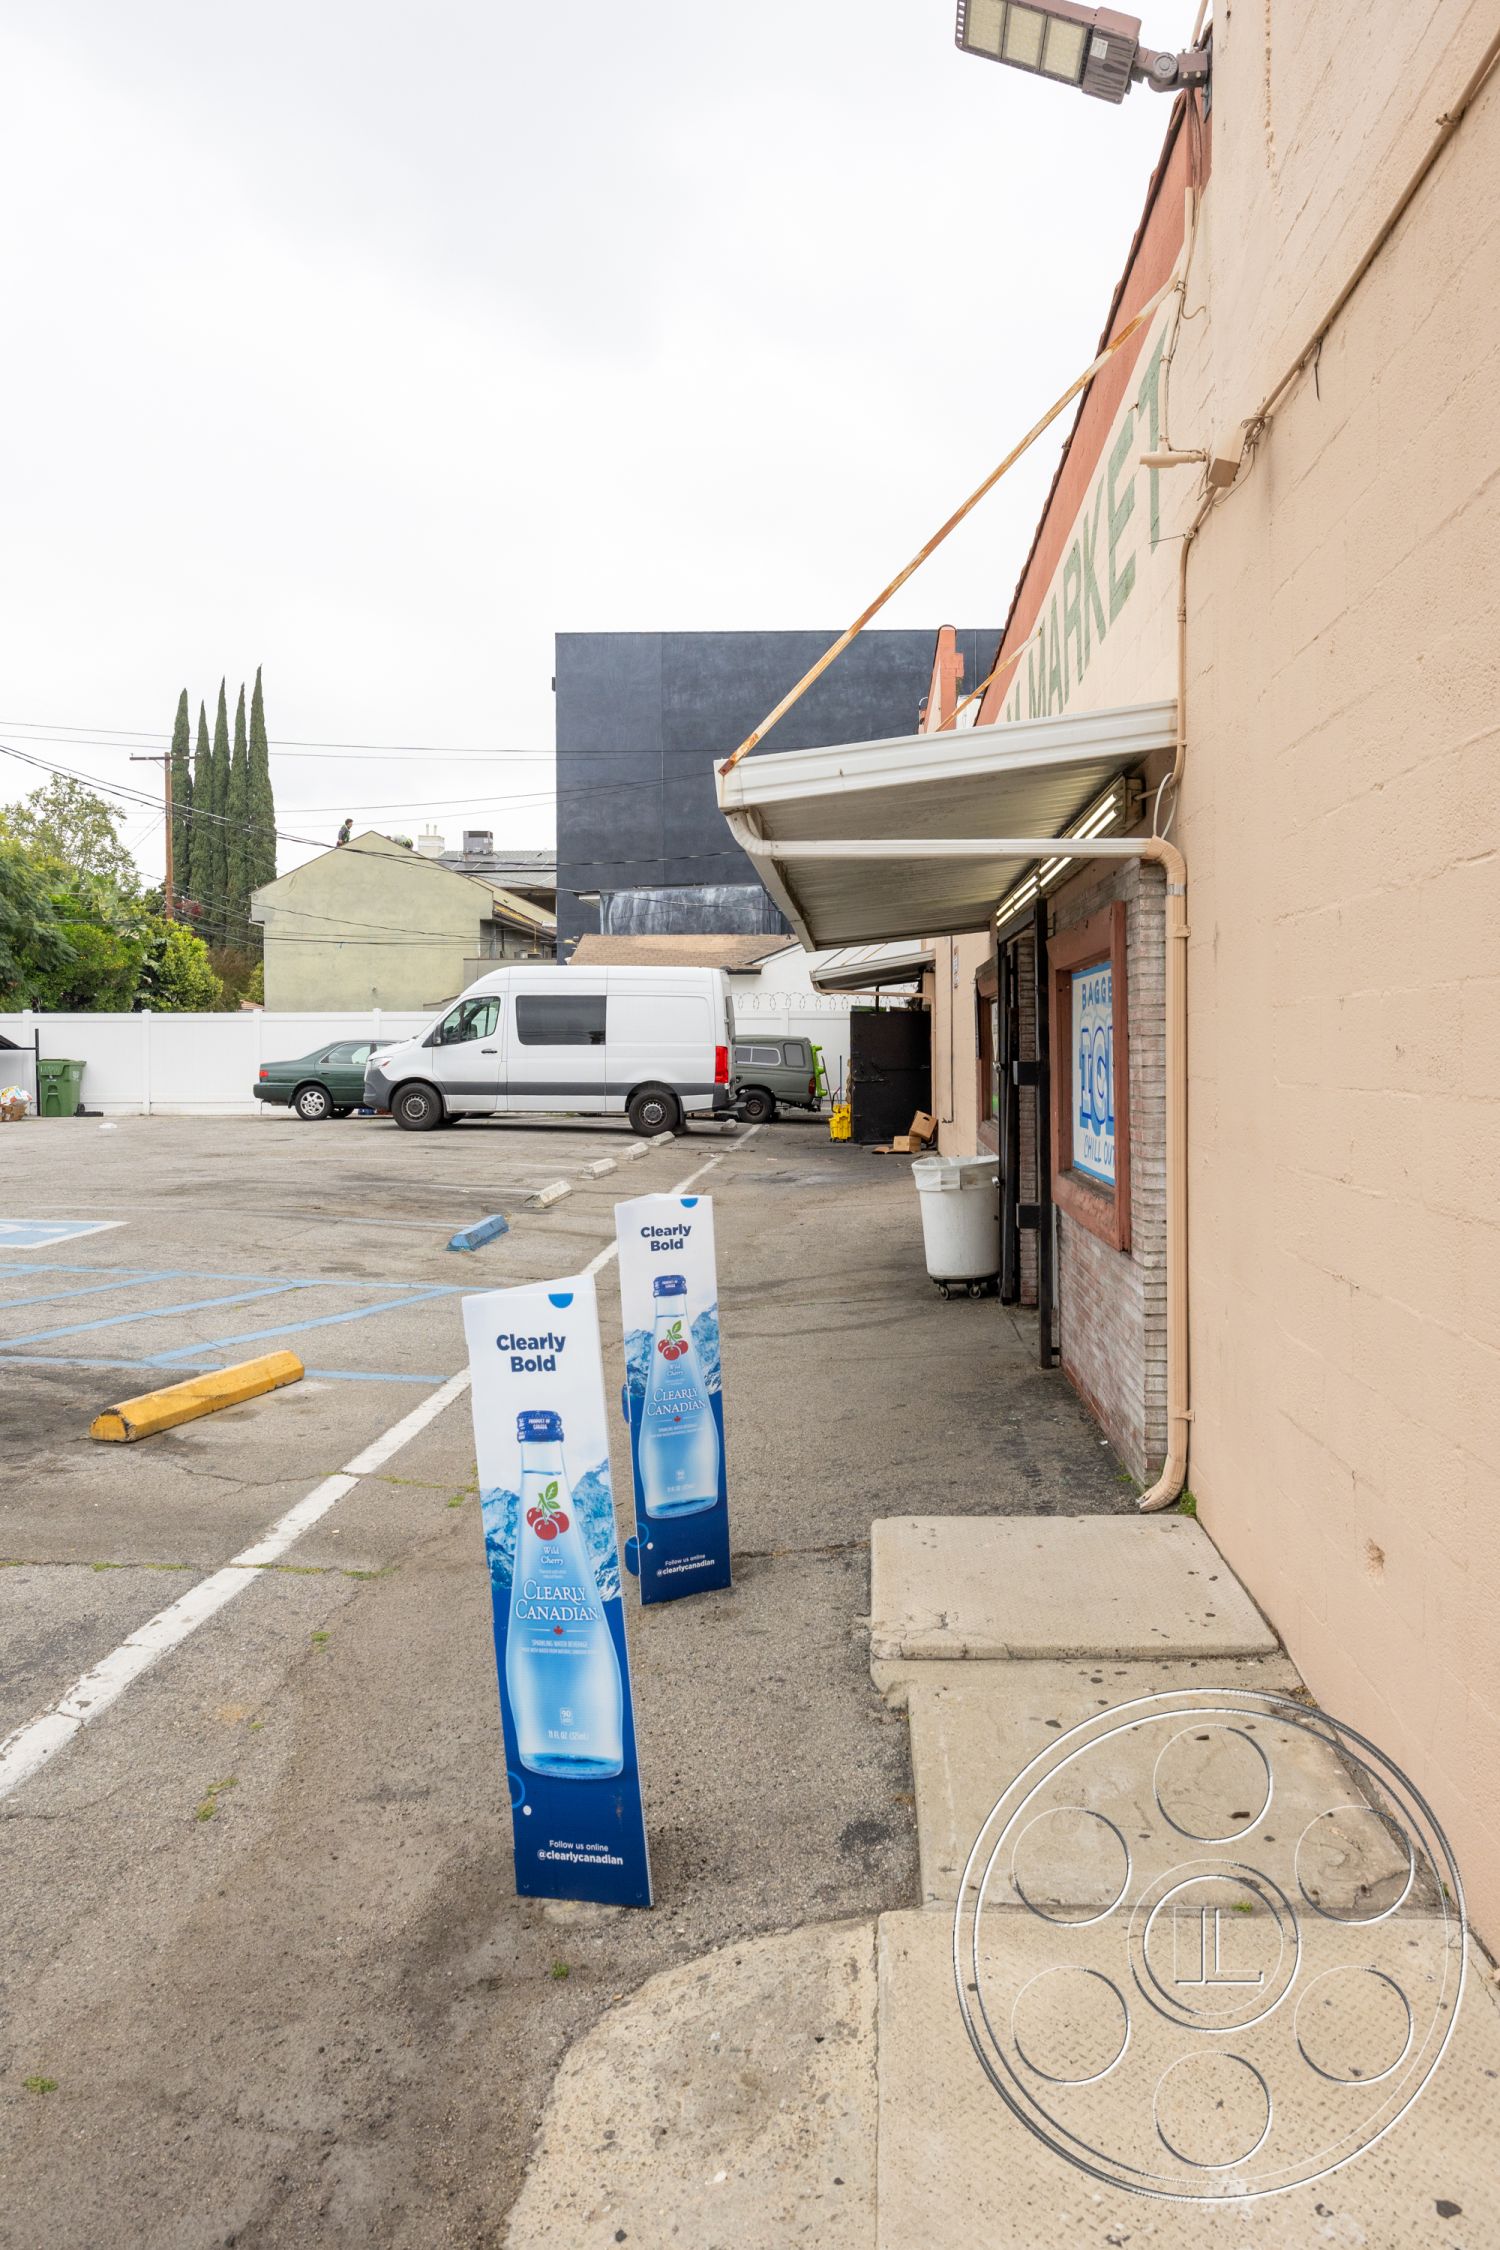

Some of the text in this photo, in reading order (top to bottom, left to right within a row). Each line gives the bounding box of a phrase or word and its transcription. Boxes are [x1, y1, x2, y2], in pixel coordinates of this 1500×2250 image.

[1027, 314, 1170, 720] MARKET
[640, 1223, 692, 1238] Clearly
[650, 1237, 684, 1252] Bold
[496, 1332, 566, 1353] Clearly
[510, 1354, 557, 1373] Bold
[653, 1387, 698, 1402] CLEARLY
[647, 1400, 706, 1416] CANADIAN
[543, 1546, 560, 1555] Wild
[540, 1555, 564, 1566] Cherry
[656, 1559, 715, 1577] @clearlycanadian
[523, 1579, 586, 1605] CLEARLY
[515, 1599, 601, 1621] CANADIAN
[549, 1840, 574, 1849] Follow
[586, 1844, 609, 1852] online
[537, 1849, 624, 1865] @clearlycanadian
